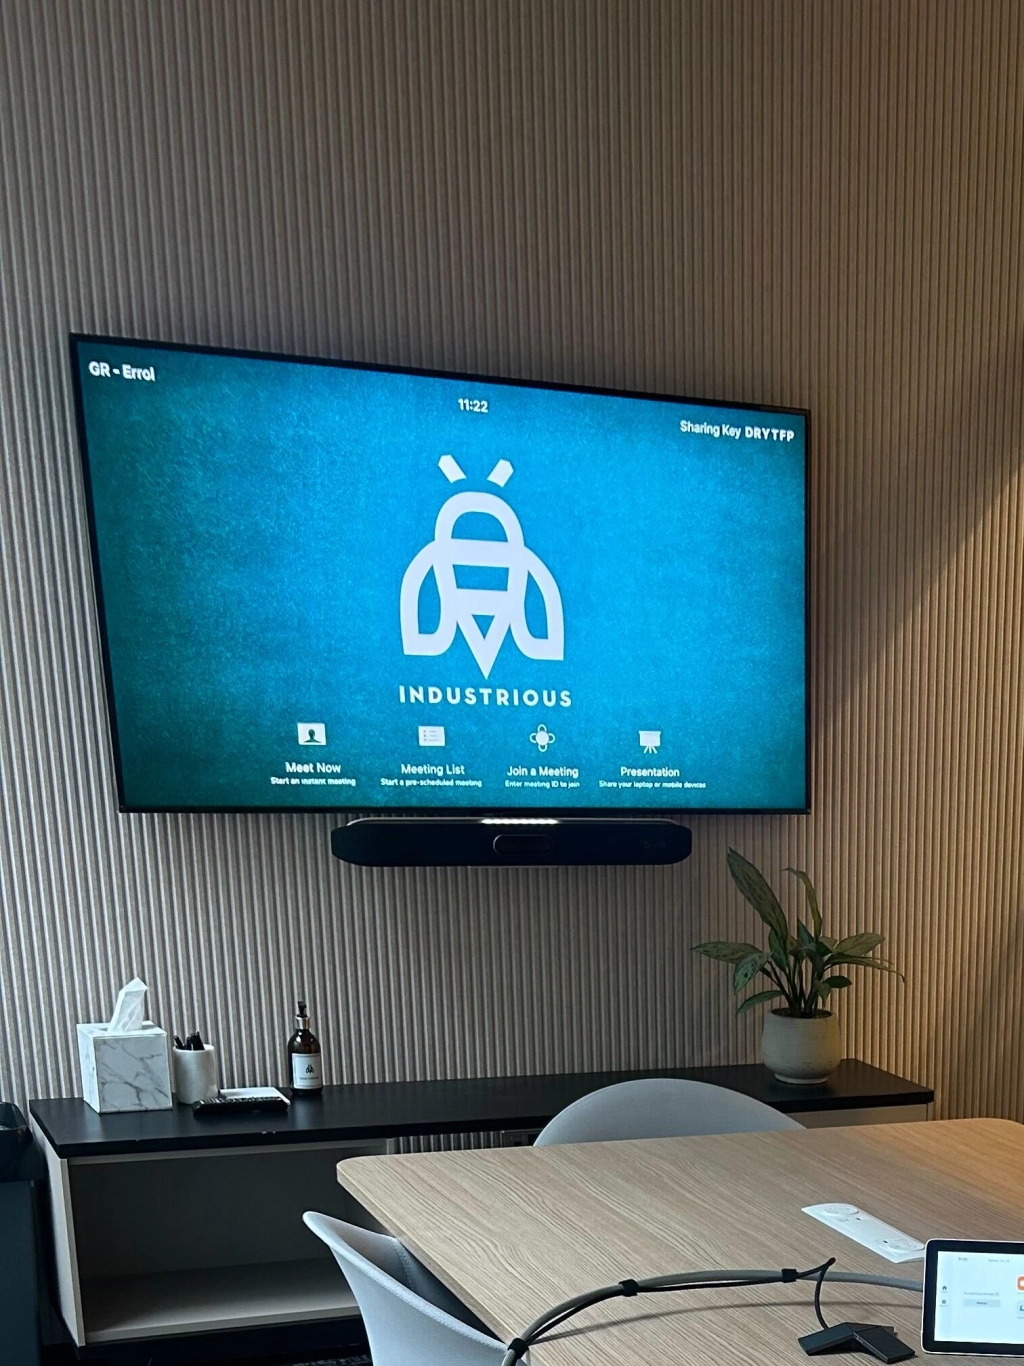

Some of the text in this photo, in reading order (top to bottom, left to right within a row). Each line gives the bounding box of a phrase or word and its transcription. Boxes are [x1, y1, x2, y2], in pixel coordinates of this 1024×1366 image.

[88, 361, 111, 377] GR
[122, 364, 156, 382] Errol
[458, 398, 489, 414] 11:22
[679, 419, 795, 443] Sharing Key DRYTFP
[398, 684, 573, 709] INDUSTRIOUS
[285, 761, 342, 774] Meet Now
[400, 763, 465, 777] Meeting List
[507, 765, 579, 779] Join a Meeting
[620, 766, 680, 777] Presentation
[270, 776, 356, 787] Start an instant meeting
[380, 777, 398, 786] Start
[405, 778, 454, 787] pre-scheduled
[454, 778, 483, 788] meeting
[504, 779, 523, 788] Enter
[523, 780, 551, 789] meeting
[551, 780, 559, 788] ID
[568, 780, 581, 789] join
[598, 780, 617, 788] Share
[618, 781, 632, 790] your
[633, 780, 653, 790] laptop
[662, 781, 683, 789] mobile
[684, 781, 707, 789] devices
